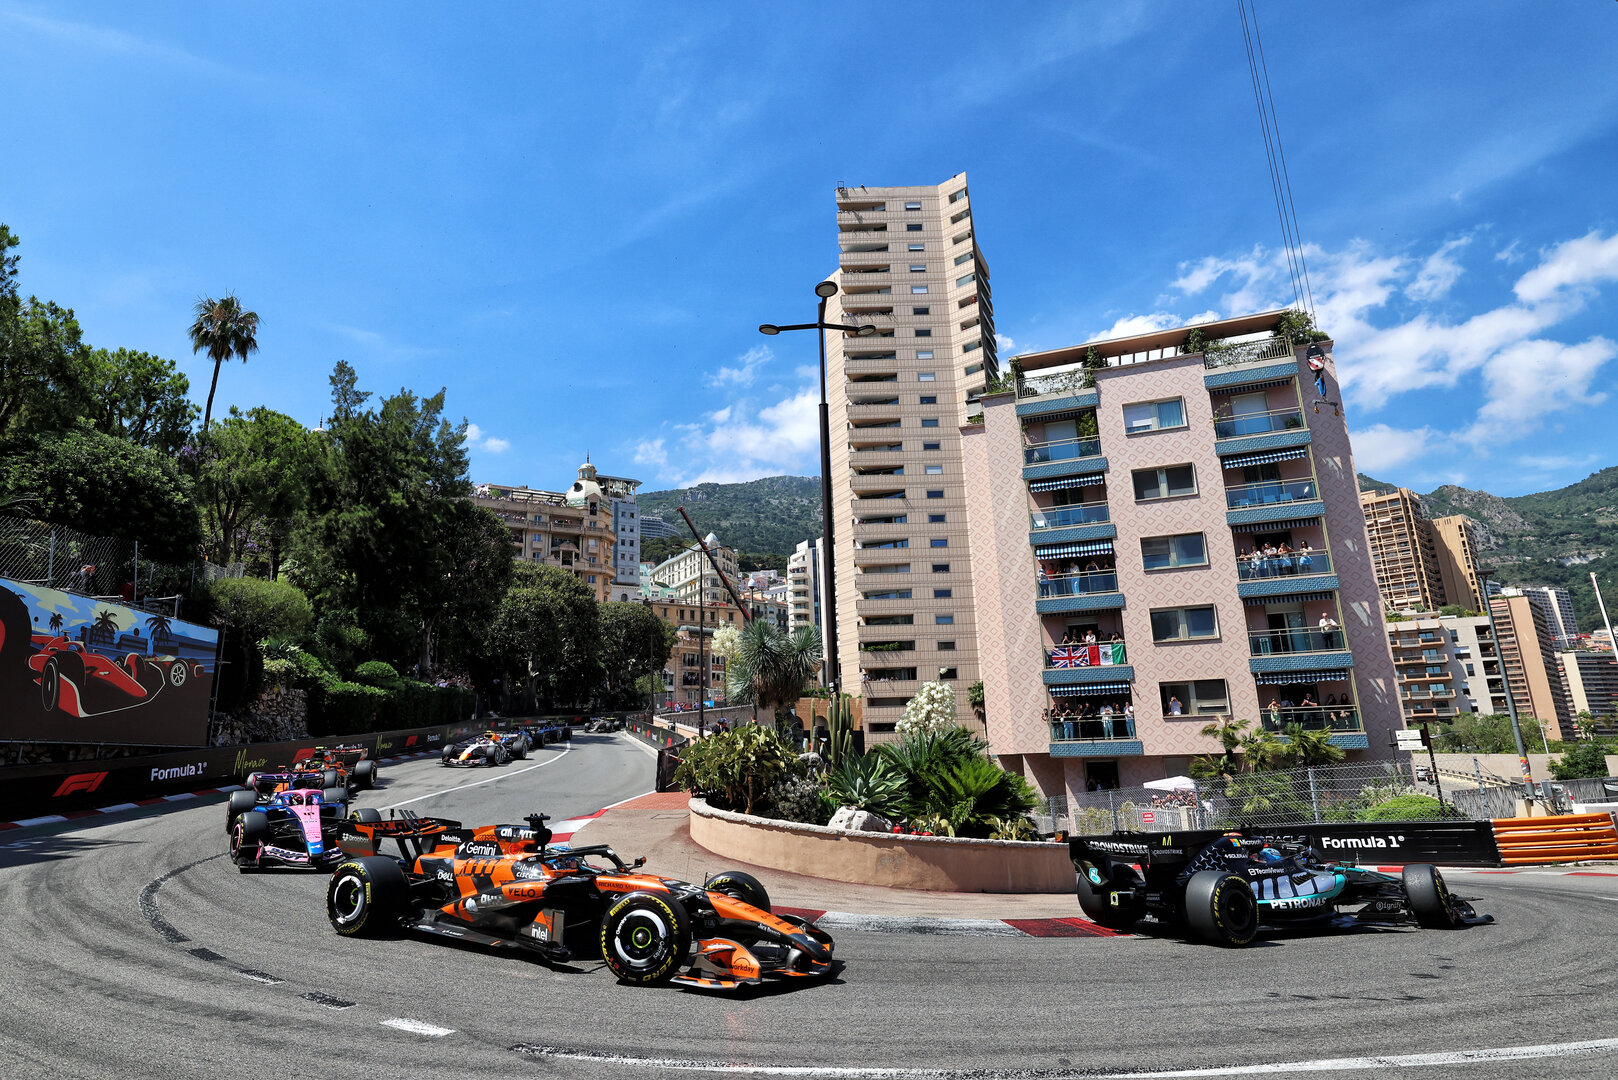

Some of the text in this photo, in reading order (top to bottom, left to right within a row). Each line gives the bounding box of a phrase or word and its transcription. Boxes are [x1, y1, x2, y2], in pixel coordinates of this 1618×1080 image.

[233, 749, 267, 777] Monaco
[151, 763, 195, 781] Formula
[466, 842, 497, 856] Gemini
[1089, 840, 1149, 854] CROWDSTRIKE
[1321, 836, 1387, 849] Formula
[437, 872, 453, 882] DELL
[1256, 867, 1285, 875] TeamViewer
[598, 881, 624, 889] RICHARD
[509, 886, 536, 898] VELO
[1269, 897, 1327, 910] PETRONAS
[531, 925, 548, 941] intel
[730, 964, 755, 973] workday
